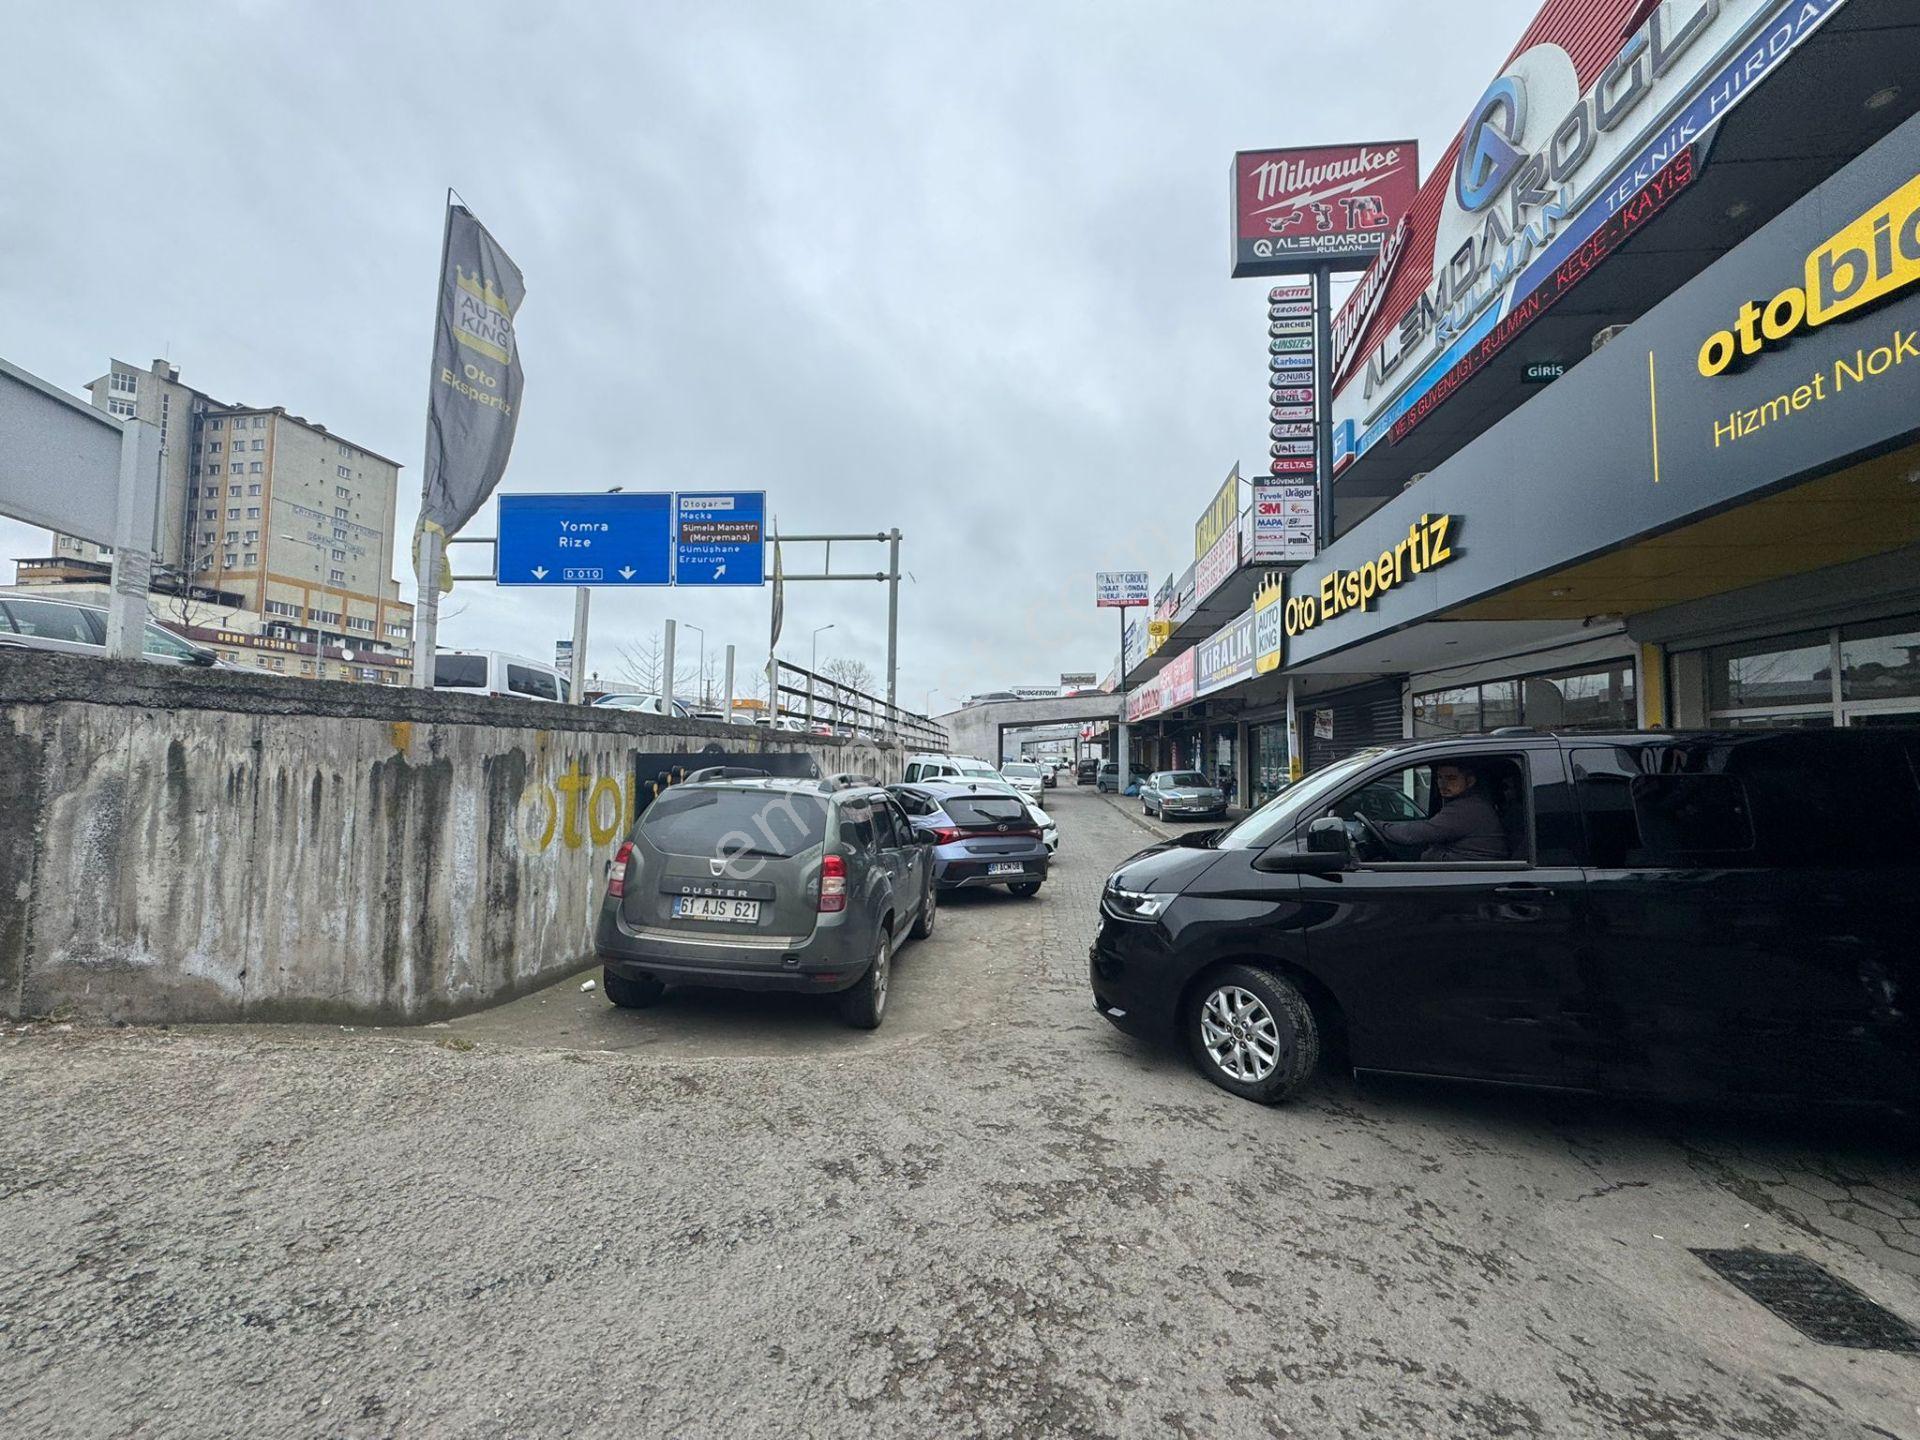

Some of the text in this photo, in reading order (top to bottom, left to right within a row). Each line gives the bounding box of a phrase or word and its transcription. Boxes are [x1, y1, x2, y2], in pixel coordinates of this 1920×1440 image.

[1605, 115, 1696, 211] TEKNİK
[1248, 148, 1400, 201] Milwaukee
[1317, 244, 1363, 254] RULMAN
[1481, 292, 1539, 358] RULMAN
[1557, 229, 1606, 291] KEÇE
[1622, 151, 1693, 229] KAYIŞ
[1436, 187, 1566, 346] RULMAN
[1273, 288, 1310, 298] LOCTITE
[461, 297, 511, 333] AUTO
[461, 312, 508, 349] KING
[1273, 356, 1312, 366] Karbosan
[463, 363, 497, 388] Oto
[1714, 371, 1826, 447] Hizmet
[683, 500, 718, 509] Otogar
[1258, 502, 1281, 515] 3M
[560, 520, 609, 532] Yomra
[682, 523, 715, 532] Sümela
[1257, 518, 1283, 527] MAPA
[559, 536, 592, 548] Rize
[689, 532, 751, 543] (Meryemana)
[679, 555, 725, 564] Erzurum
[1285, 596, 1316, 637] Oto
[1320, 513, 1452, 621] Ekspertiz
[1257, 607, 1279, 633] AUTO
[1257, 628, 1278, 653] KING
[1016, 688, 1058, 696] BRIDGESTONE
[682, 886, 749, 897] DUSTER
[681, 898, 757, 918] 61 AJS 621
